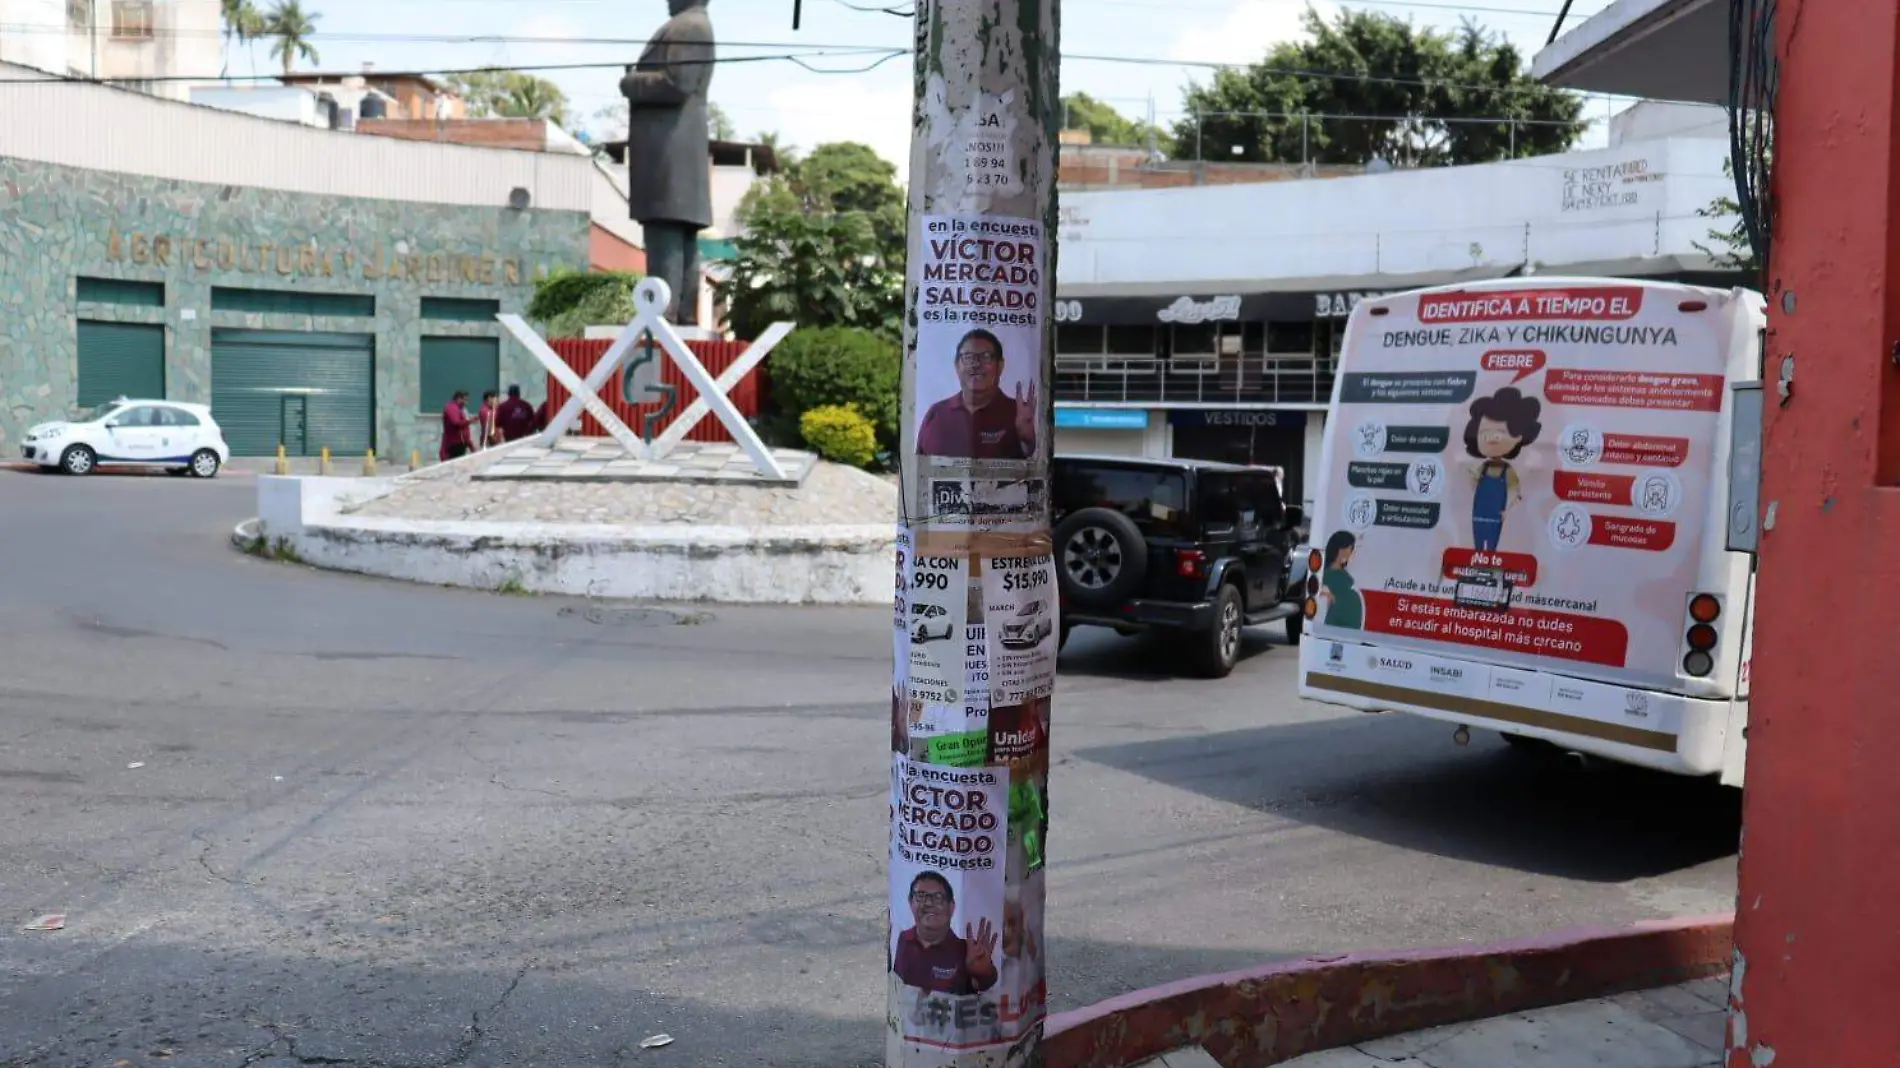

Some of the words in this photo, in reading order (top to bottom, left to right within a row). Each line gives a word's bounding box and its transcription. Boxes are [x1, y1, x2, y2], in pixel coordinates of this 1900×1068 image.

[928, 220, 947, 232] en
[952, 219, 965, 231] la
[930, 233, 1035, 264] VÍCTOR
[923, 263, 1039, 286] MERCADO
[925, 286, 1037, 309] SALGADO
[923, 310, 939, 320] es
[944, 308, 957, 320] la
[1423, 298, 1513, 319] IDENTIFICA
[1516, 299, 1531, 315] A
[1536, 297, 1605, 316] TIEMPO
[1609, 296, 1634, 315] EL
[1458, 326, 1500, 345] ZIKA
[1505, 326, 1518, 342] Y
[1522, 325, 1678, 347] CHIKUNGUNYA
[1488, 353, 1534, 369] FIEBRE
[1563, 371, 1582, 381] Para
[1583, 373, 1637, 384] considerarlo
[1638, 375, 1670, 386] dengue
[1548, 382, 1580, 393] además
[1581, 382, 1593, 392] de
[1594, 383, 1606, 393] los
[1648, 386, 1714, 398] anteriormente
[1562, 394, 1618, 405] mencionados
[1205, 410, 1277, 426] VESTIDOS
[1608, 440, 1631, 449] Dolor
[1567, 488, 1613, 500] persistente
[1604, 521, 1645, 534] Sangrado
[1646, 526, 1657, 535] de
[930, 557, 959, 570] CON
[1491, 553, 1503, 566] te
[1384, 577, 1418, 592] ¡Acude
[989, 603, 1015, 612] MARCH
[1397, 599, 1409, 613] Si
[1410, 602, 1442, 616] estás
[1443, 606, 1516, 626] embarazada
[1517, 617, 1534, 629] no
[1389, 617, 1402, 628] en
[1404, 617, 1438, 633] acudir
[1441, 619, 1452, 634] al
[1454, 622, 1502, 642] hospital
[1504, 628, 1530, 647] más
[967, 645, 986, 657] EN
[1380, 657, 1412, 669] SALUD
[1431, 667, 1463, 678] INSABI
[920, 690, 942, 701] 9752
[936, 740, 961, 751] Gran
[922, 769, 995, 784] encuesta
[915, 850, 992, 868] respuesta
